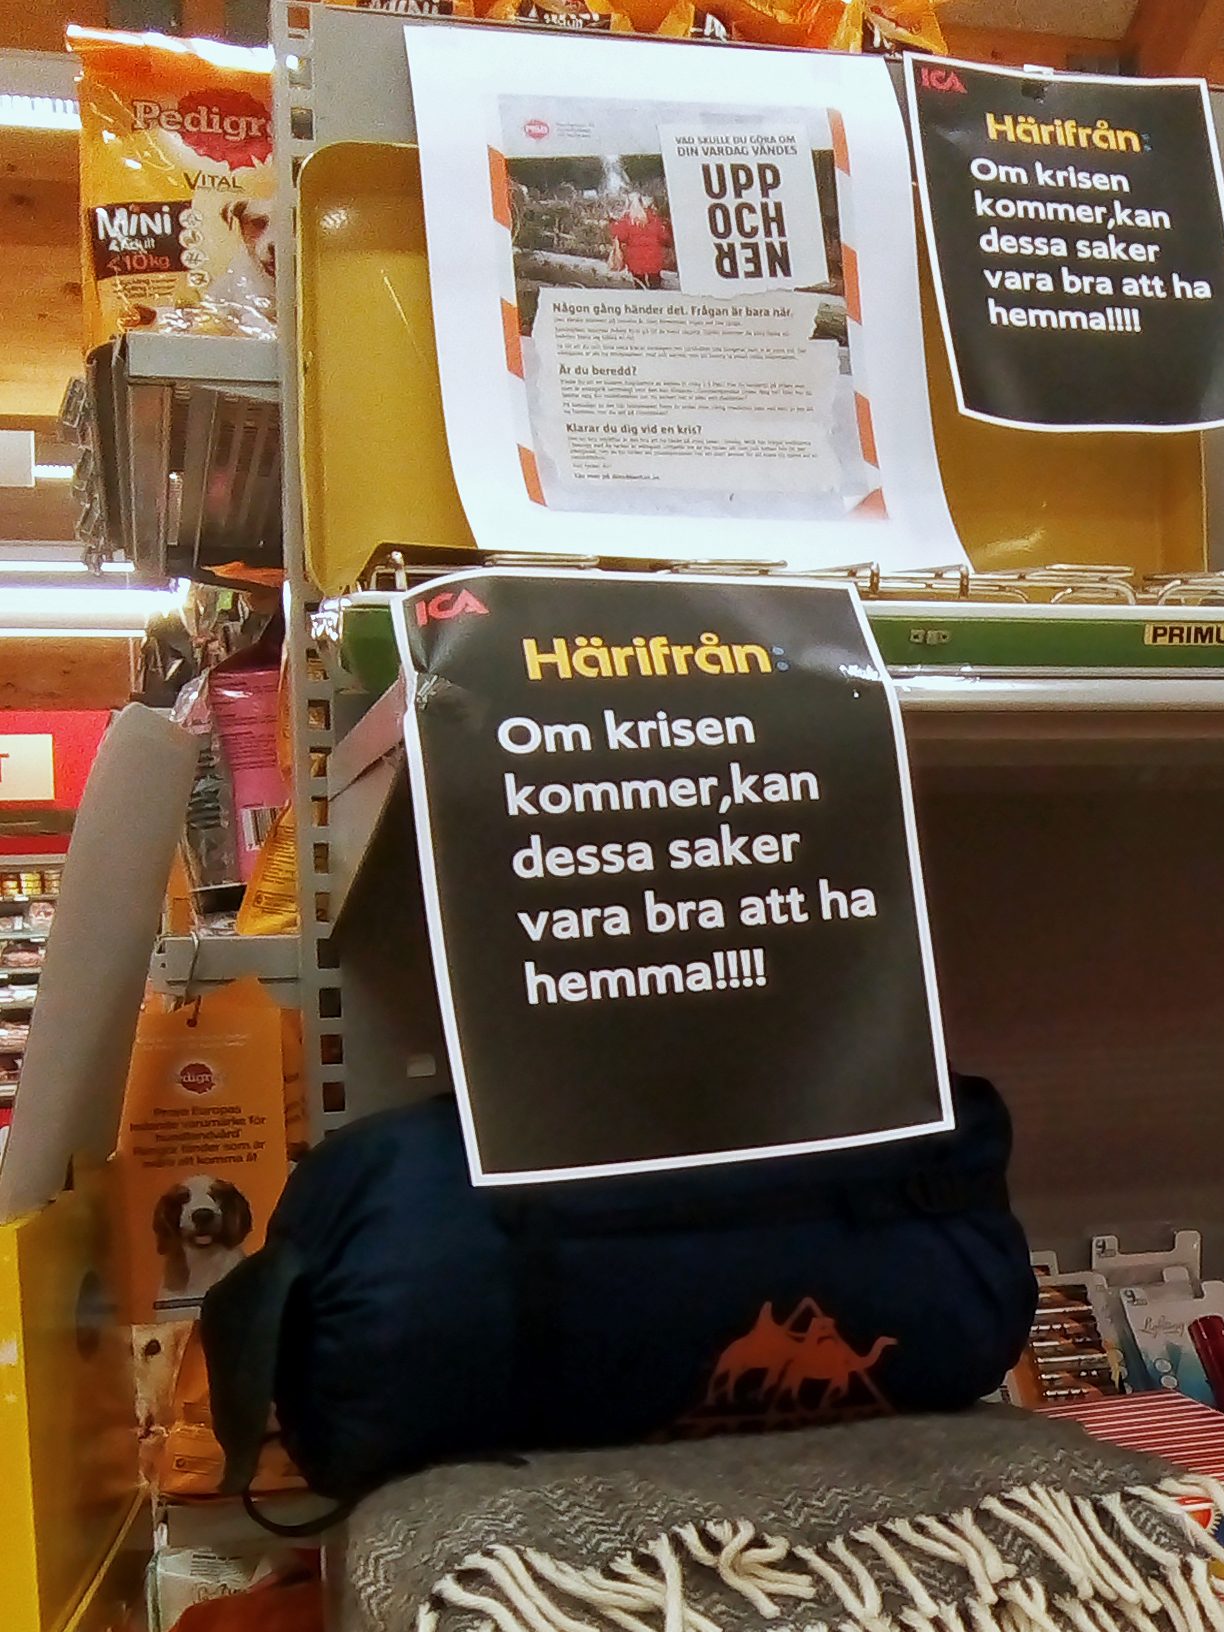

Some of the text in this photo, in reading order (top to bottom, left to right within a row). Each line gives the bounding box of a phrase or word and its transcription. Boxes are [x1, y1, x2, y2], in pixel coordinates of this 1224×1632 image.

[675, 135, 797, 145] VAD DU OM
[677, 145, 749, 157] DIN VARDAG
[183, 170, 243, 191] VITAL
[701, 162, 782, 200] UPP
[969, 156, 1131, 194] Om krisen
[707, 201, 786, 240] OCH
[973, 189, 1172, 231] kommer,kan
[715, 241, 793, 280] NER
[978, 226, 1161, 264] dessa saker
[983, 266, 1212, 300] vara bra att ha
[552, 302, 771, 318] Någon gång händer Frågan är bara
[559, 362, 638, 377] Är du beredd?
[566, 422, 703, 436] Klarar du dig vid en kris?
[497, 709, 756, 755] Om krisen
[504, 762, 820, 817] kommer,kan
[511, 823, 801, 879] dessa saker
[517, 878, 878, 941] vara bra att ha
[523, 947, 768, 1006] hemma!!!!
